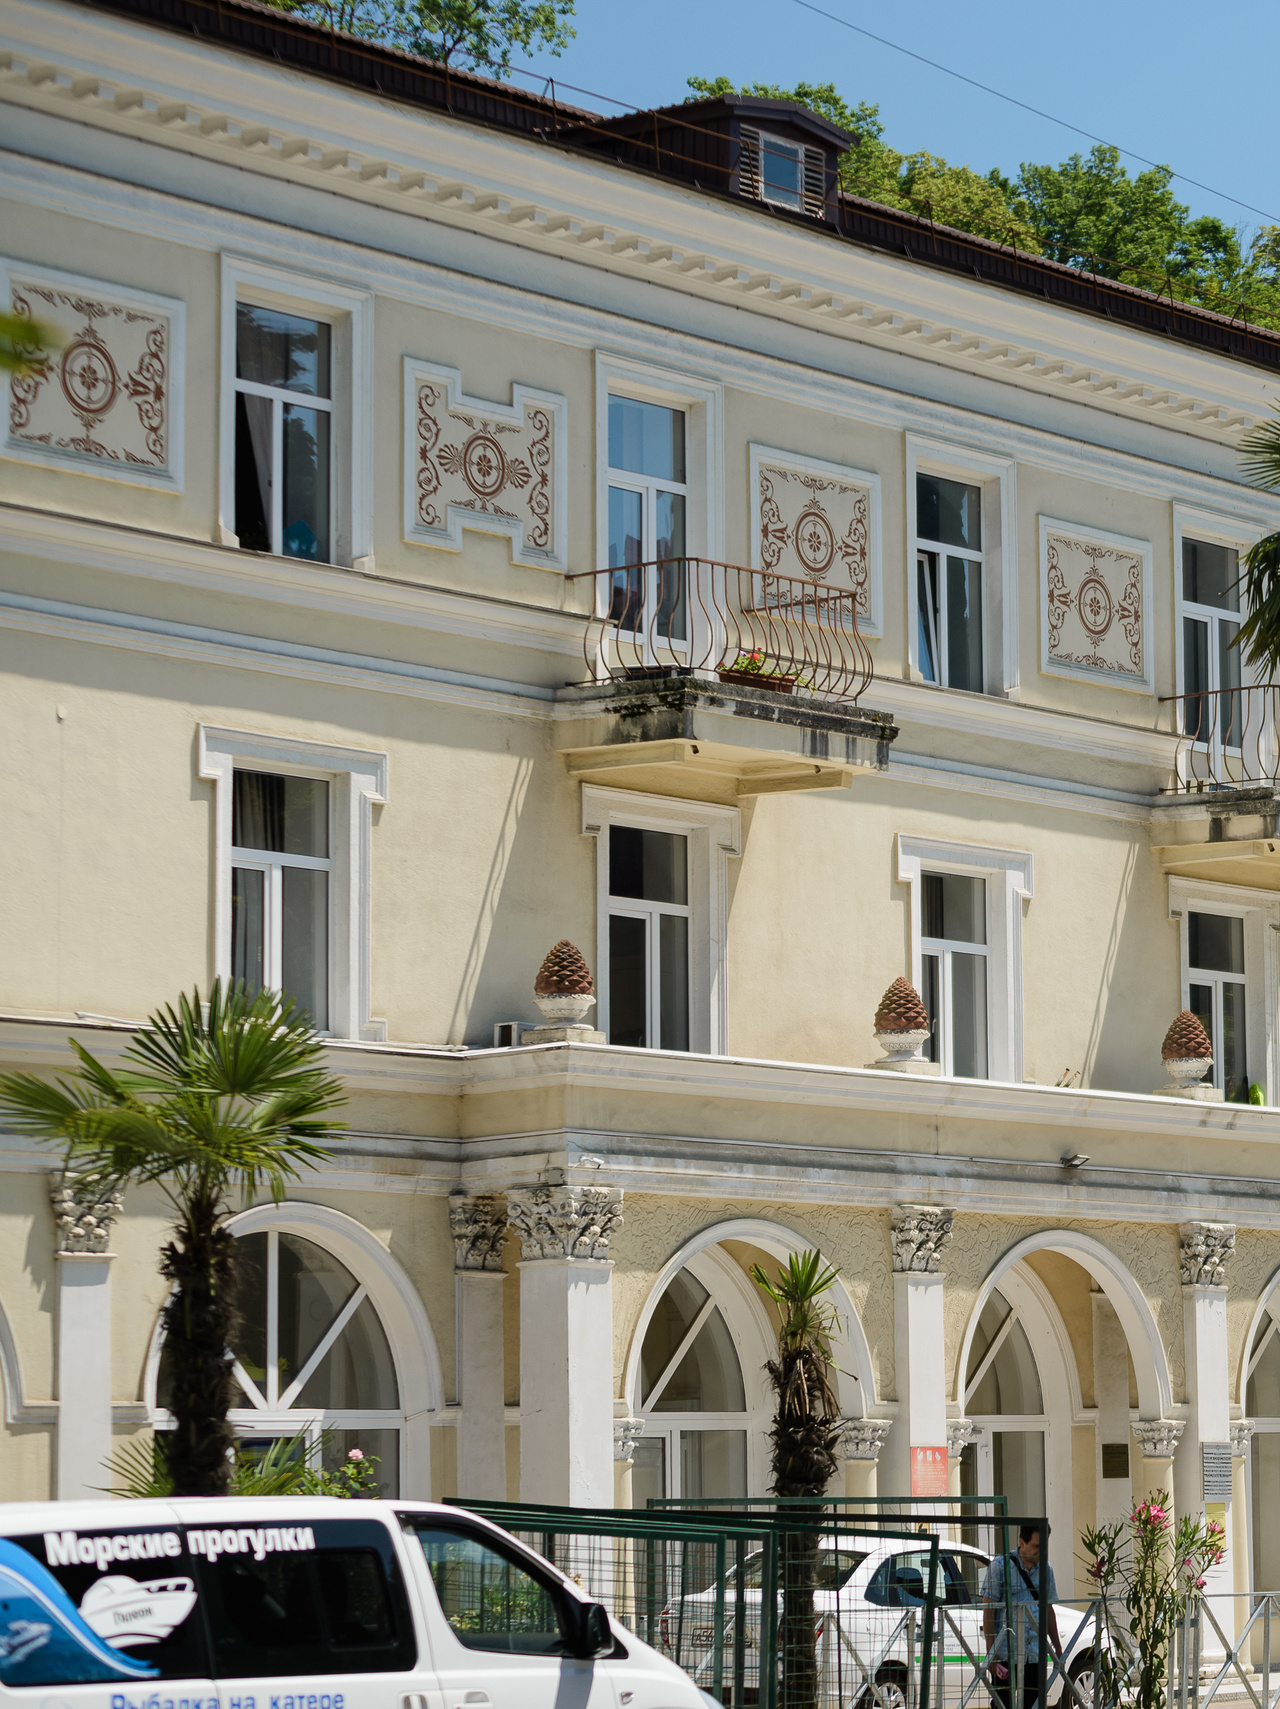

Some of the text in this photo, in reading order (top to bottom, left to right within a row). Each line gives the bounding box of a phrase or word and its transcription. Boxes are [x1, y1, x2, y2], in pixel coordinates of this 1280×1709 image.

[43, 1526, 316, 1572] Морские прогулки
[109, 1692, 345, 1709] Рыбалка на катере
